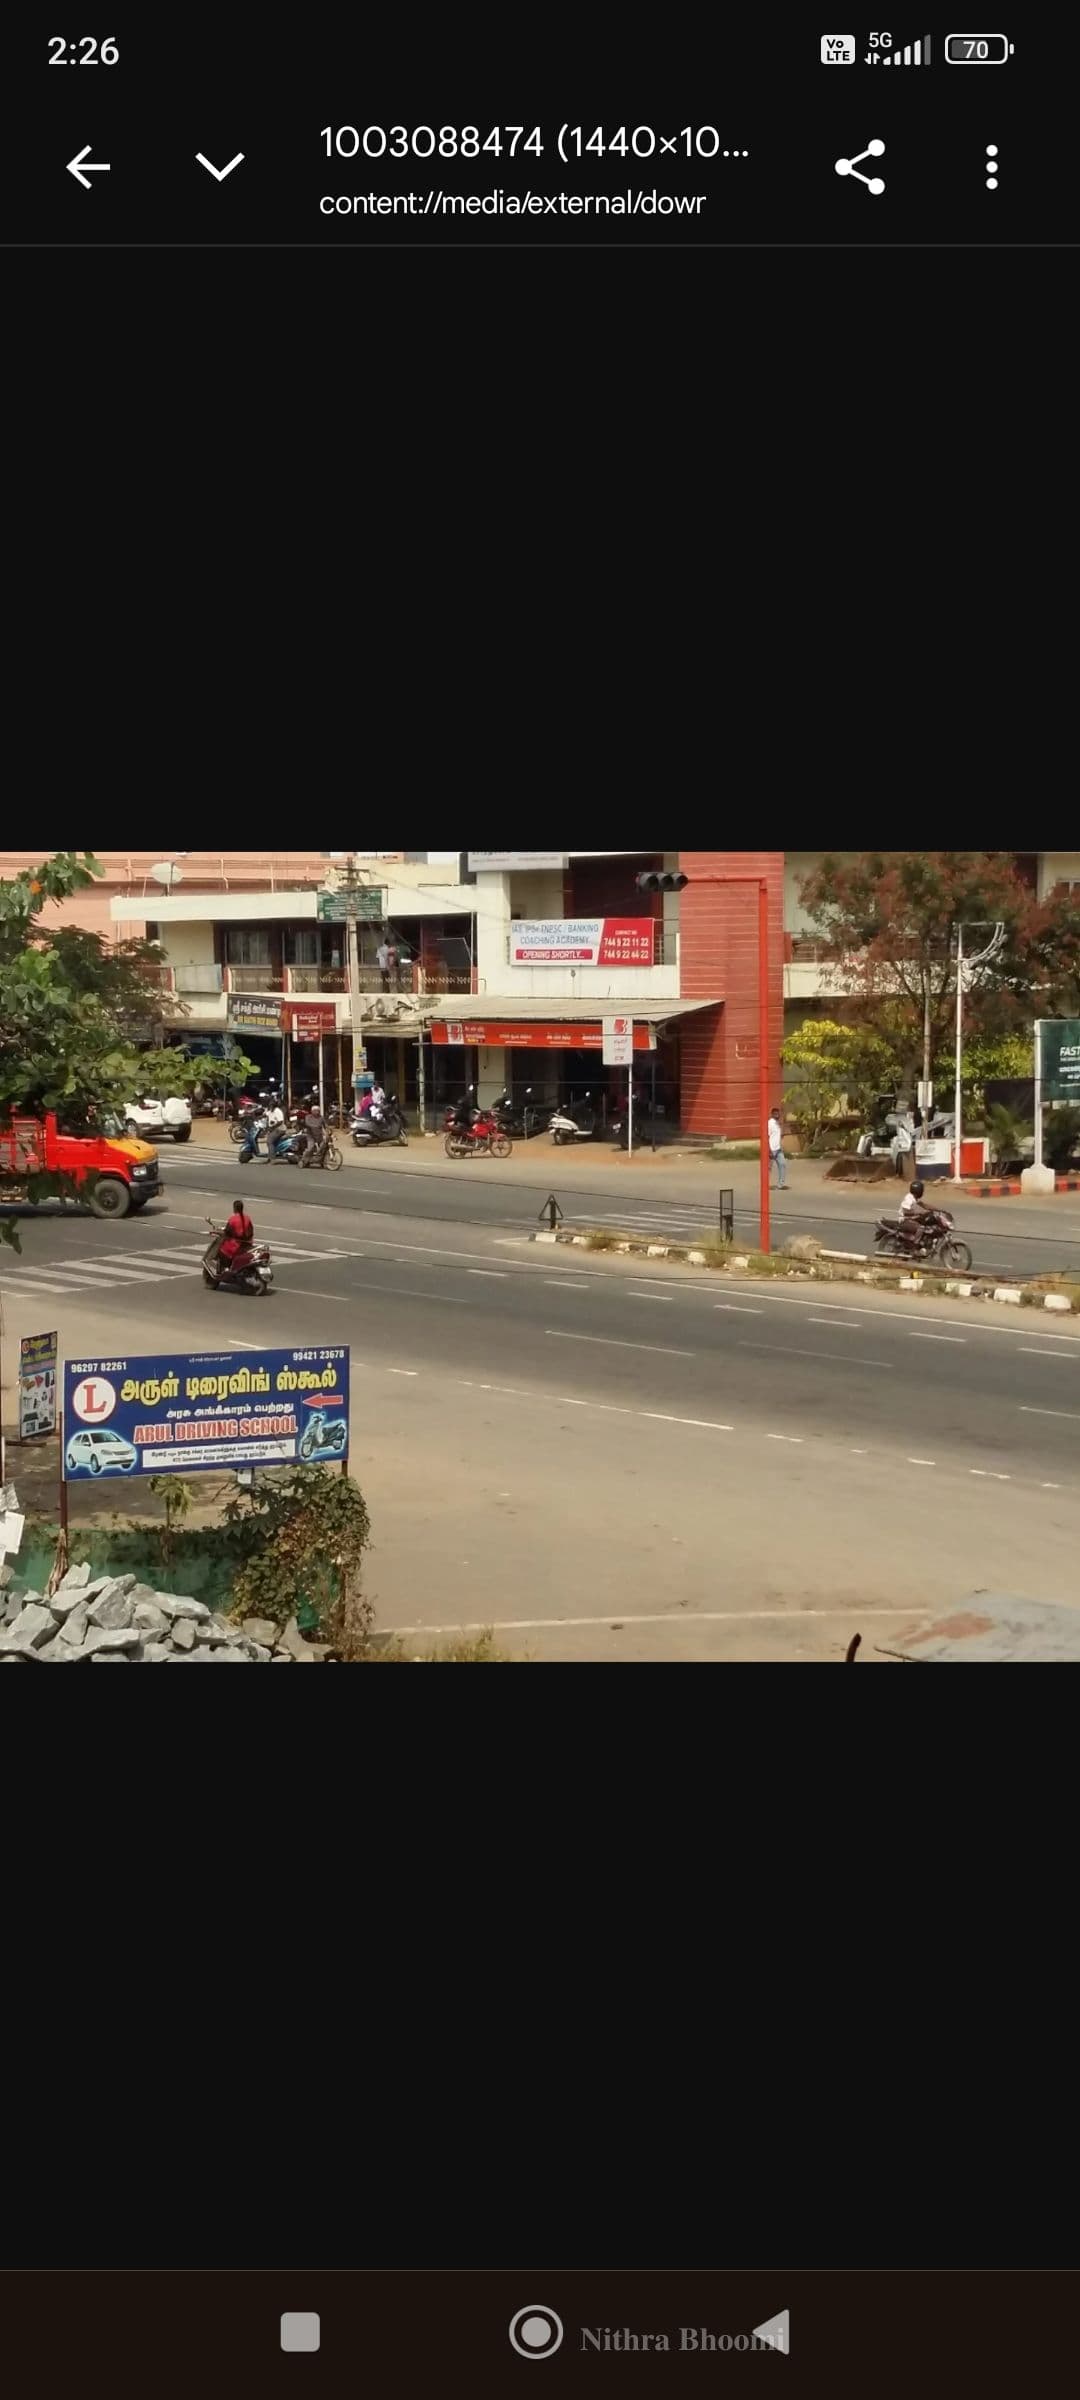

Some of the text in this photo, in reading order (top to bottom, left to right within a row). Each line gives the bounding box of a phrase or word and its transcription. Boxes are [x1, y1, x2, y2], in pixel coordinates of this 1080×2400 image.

[826, 39, 844, 49] Vo
[868, 32, 893, 48] 5G
[962, 40, 989, 59] 70
[48, 37, 120, 65] 2:26
[826, 51, 851, 61] LTE
[320, 125, 545, 158] 1003088474
[293, 1351, 317, 1361] 99421
[71, 1362, 127, 1374] 96297 82261
[121, 1361, 338, 1406] அருள் டிரைவிங் ஸ்கூல்
[83, 1384, 107, 1414] L
[133, 1415, 299, 1445] ARUL DRIVING SCHOOL
